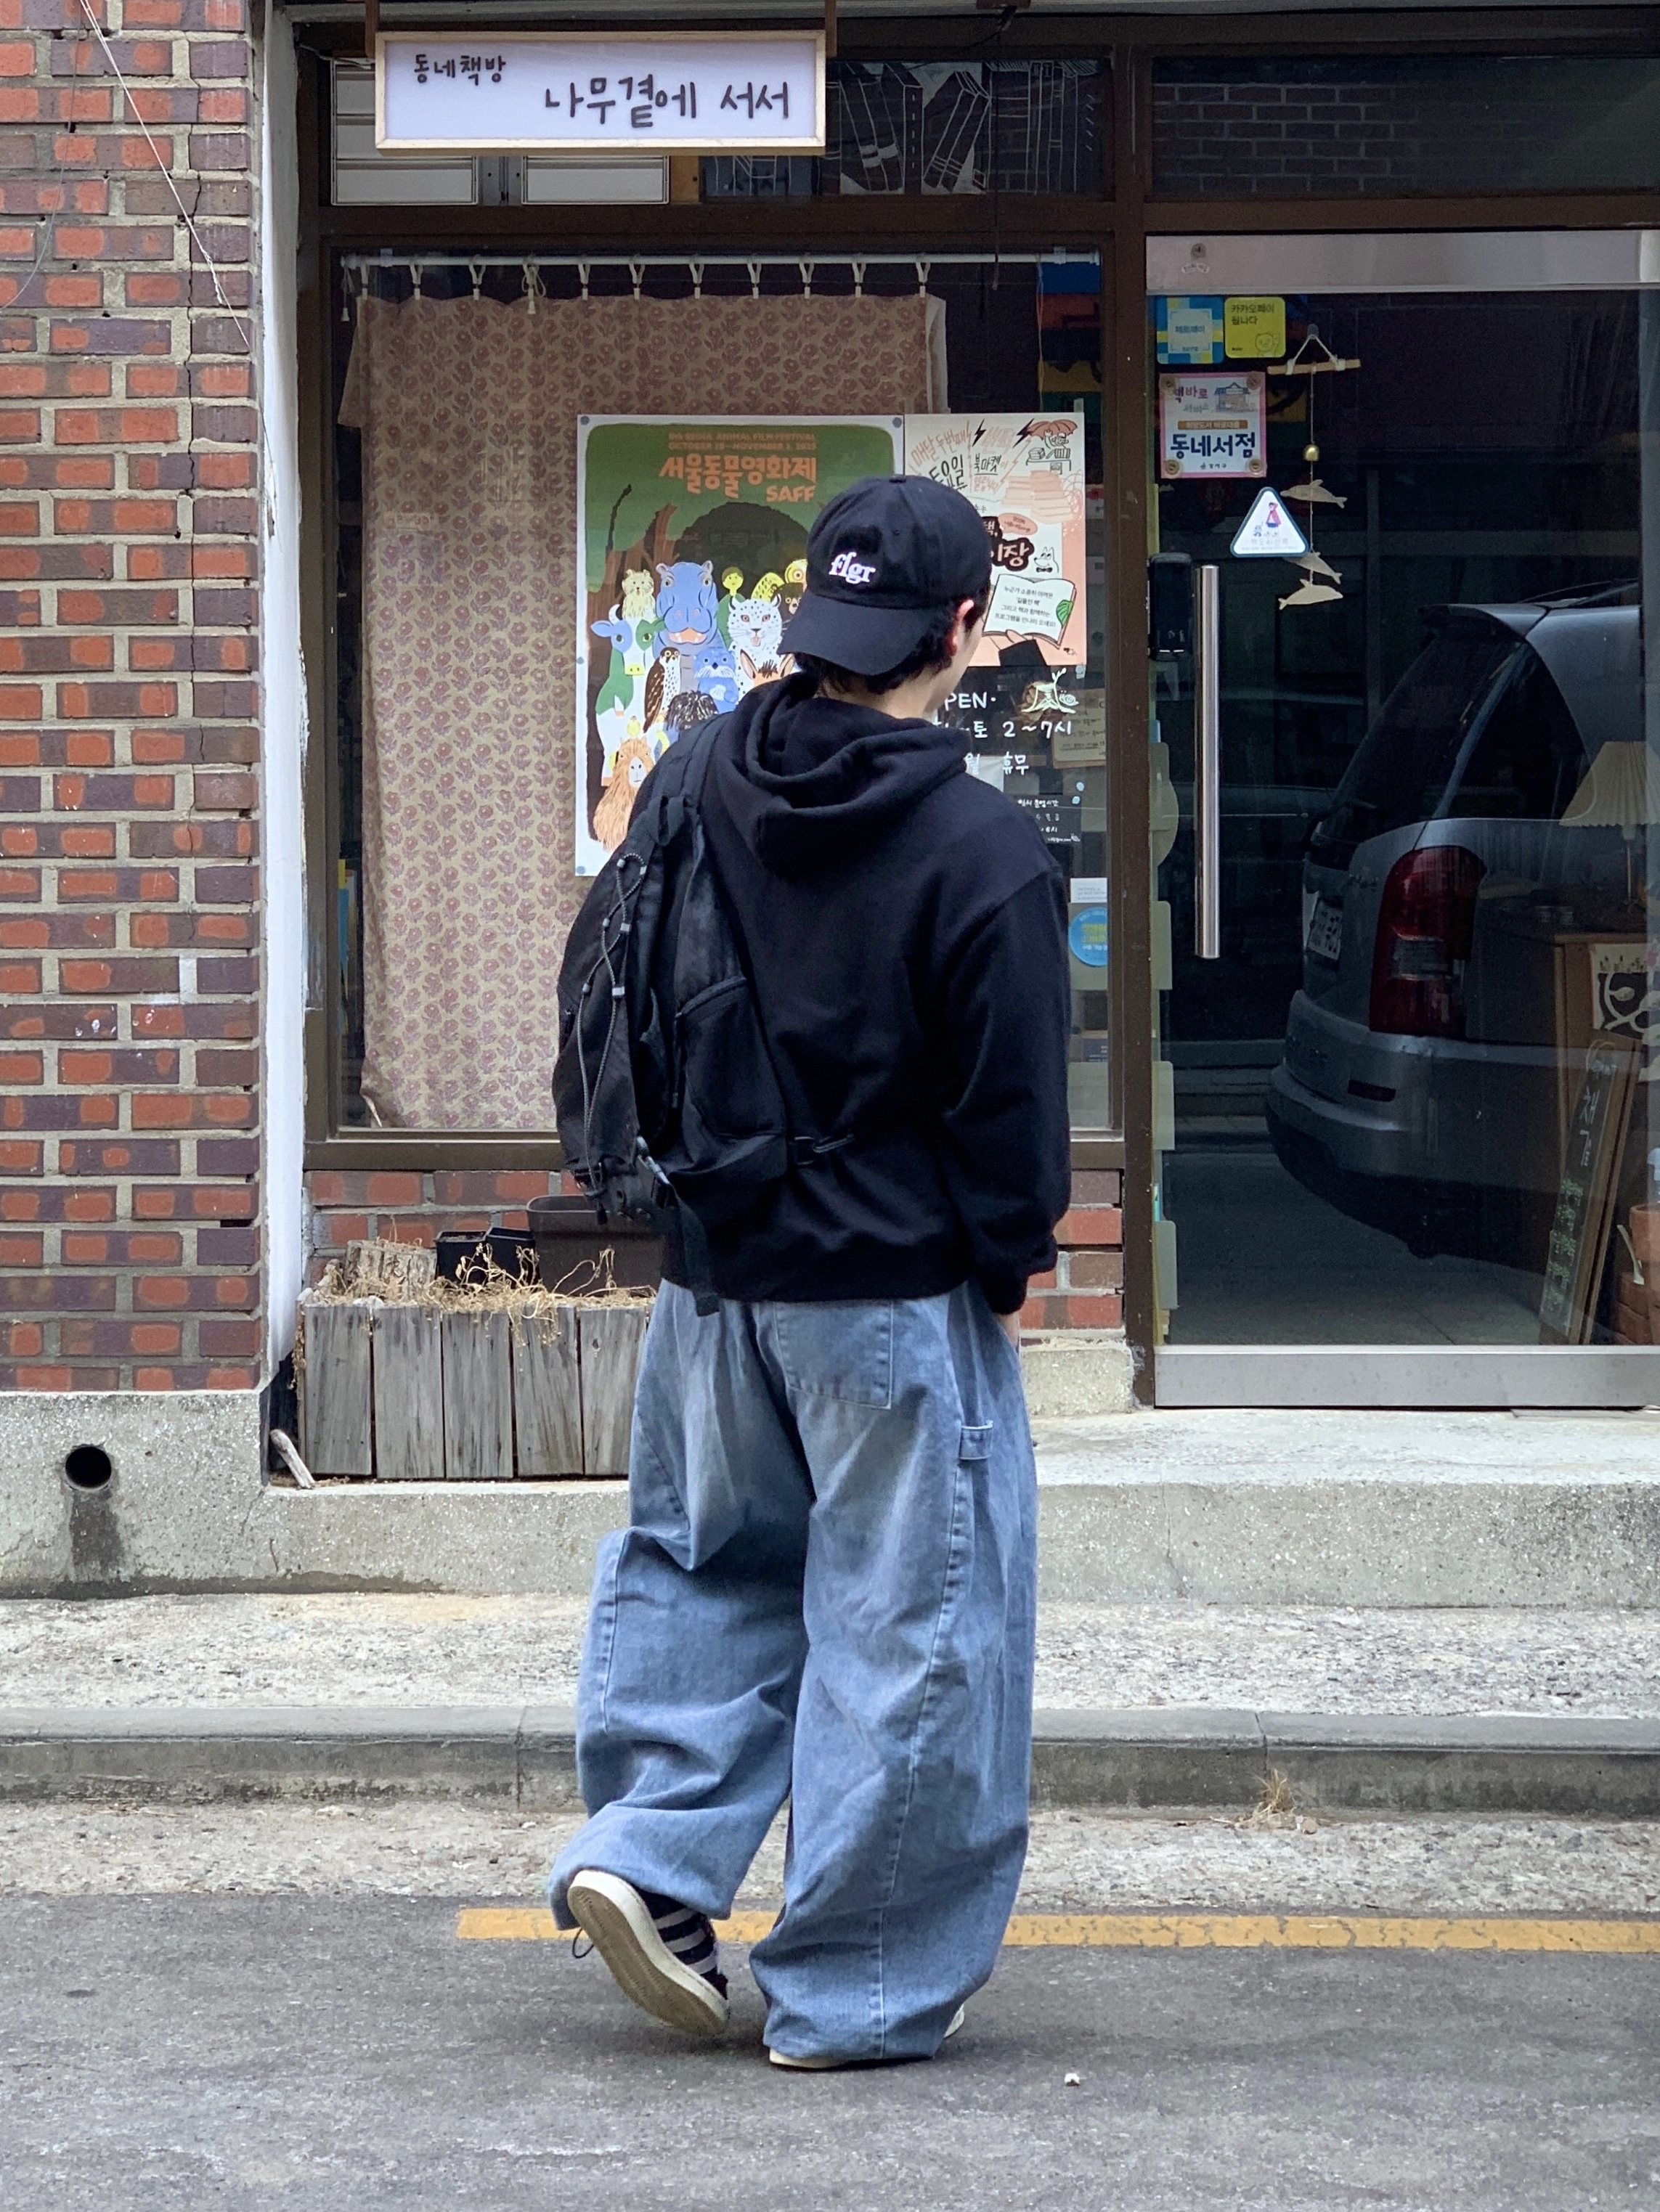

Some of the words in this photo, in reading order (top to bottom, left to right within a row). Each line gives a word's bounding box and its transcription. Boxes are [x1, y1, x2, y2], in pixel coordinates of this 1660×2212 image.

[414, 54, 507, 86] 동네책방
[545, 73, 696, 128] 나무곁에
[720, 82, 789, 119] 서서
[1231, 303, 1274, 314] 카카오페이
[1231, 315, 1258, 325] 됩니다
[717, 433, 752, 441] ANIMAL
[753, 433, 774, 441] FILM
[774, 432, 816, 441] FESTIVAL
[1170, 431, 1256, 460] 동네서점
[911, 436, 941, 468] 매달
[659, 453, 817, 499] 서울동물영화제
[765, 484, 815, 503] SAFF
[1002, 751, 1029, 776] 휴무
